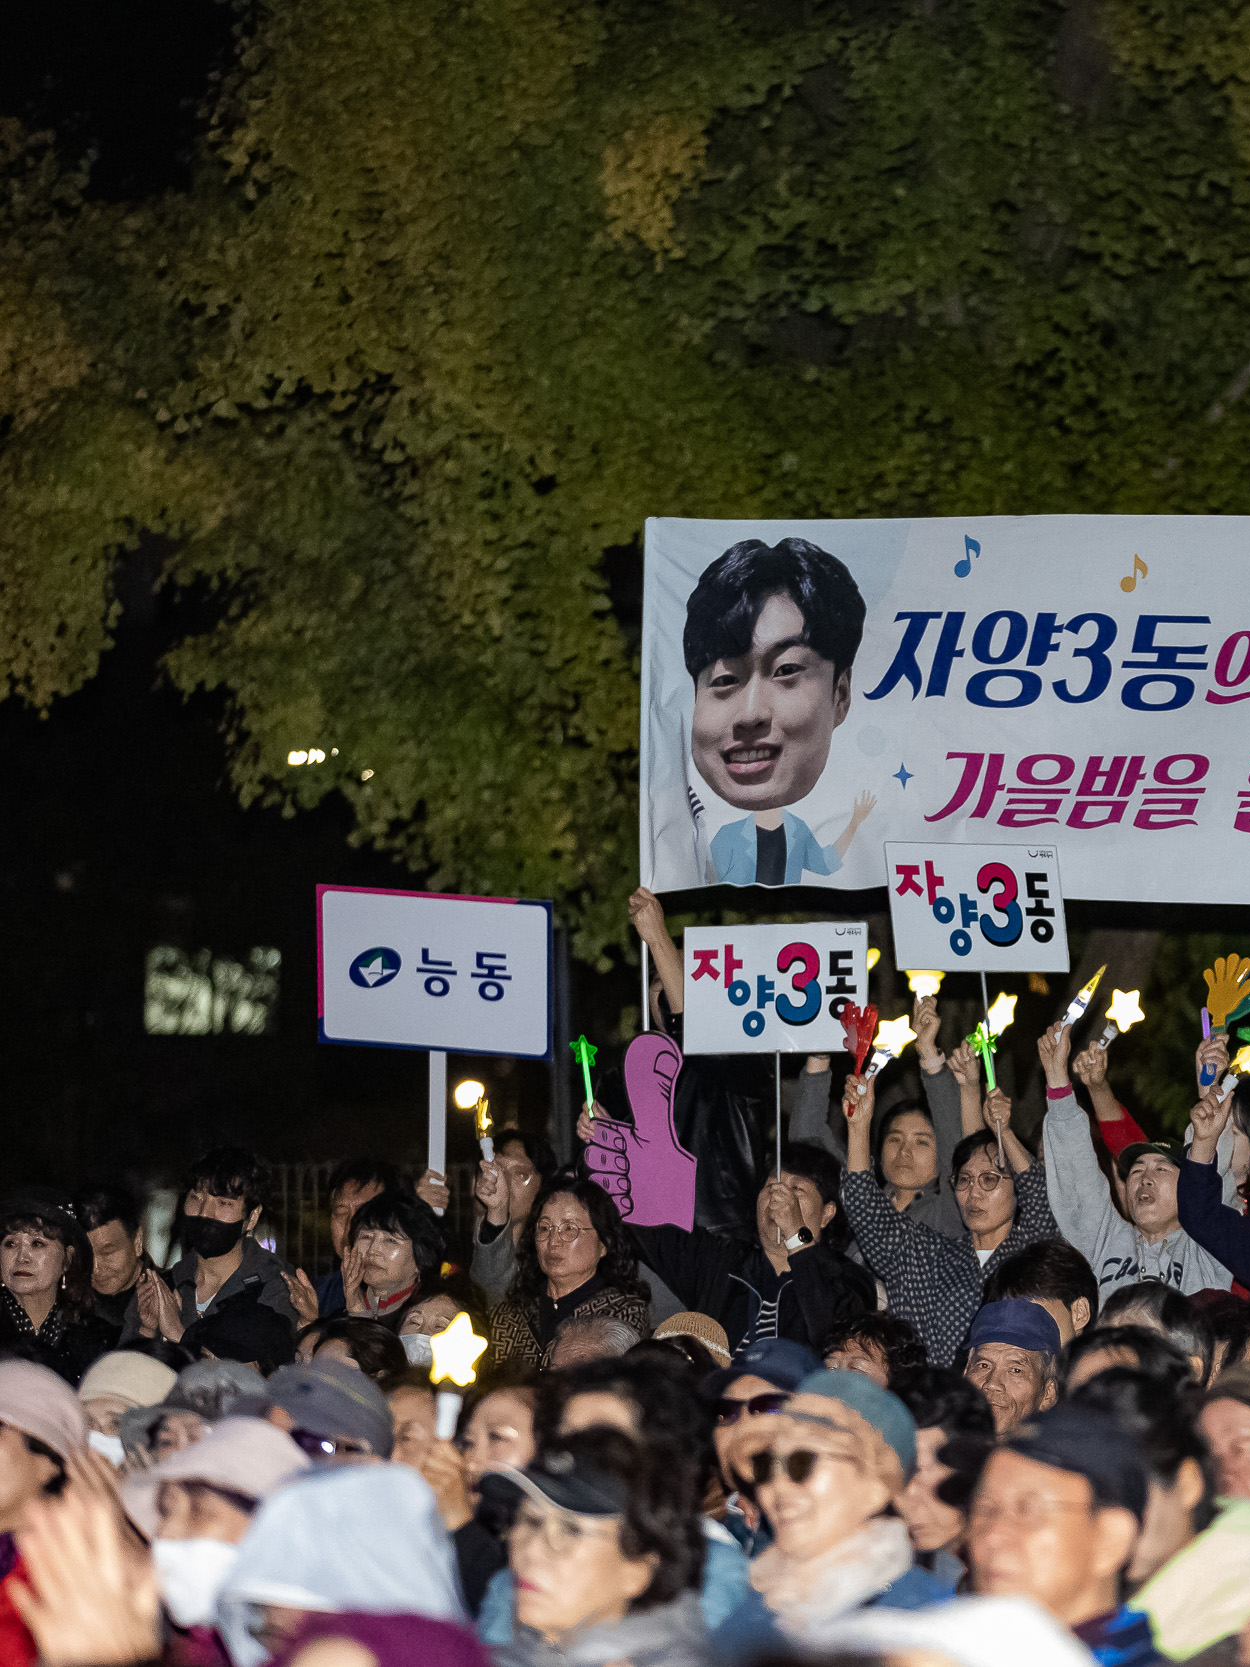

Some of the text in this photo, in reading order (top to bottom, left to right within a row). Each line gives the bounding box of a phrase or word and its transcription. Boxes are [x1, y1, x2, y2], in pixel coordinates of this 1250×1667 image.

[924, 751, 1211, 831] 가을밤을
[895, 860, 1056, 957] 자양3동
[416, 947, 513, 1002] 능동
[690, 941, 858, 1038] 자양3동
